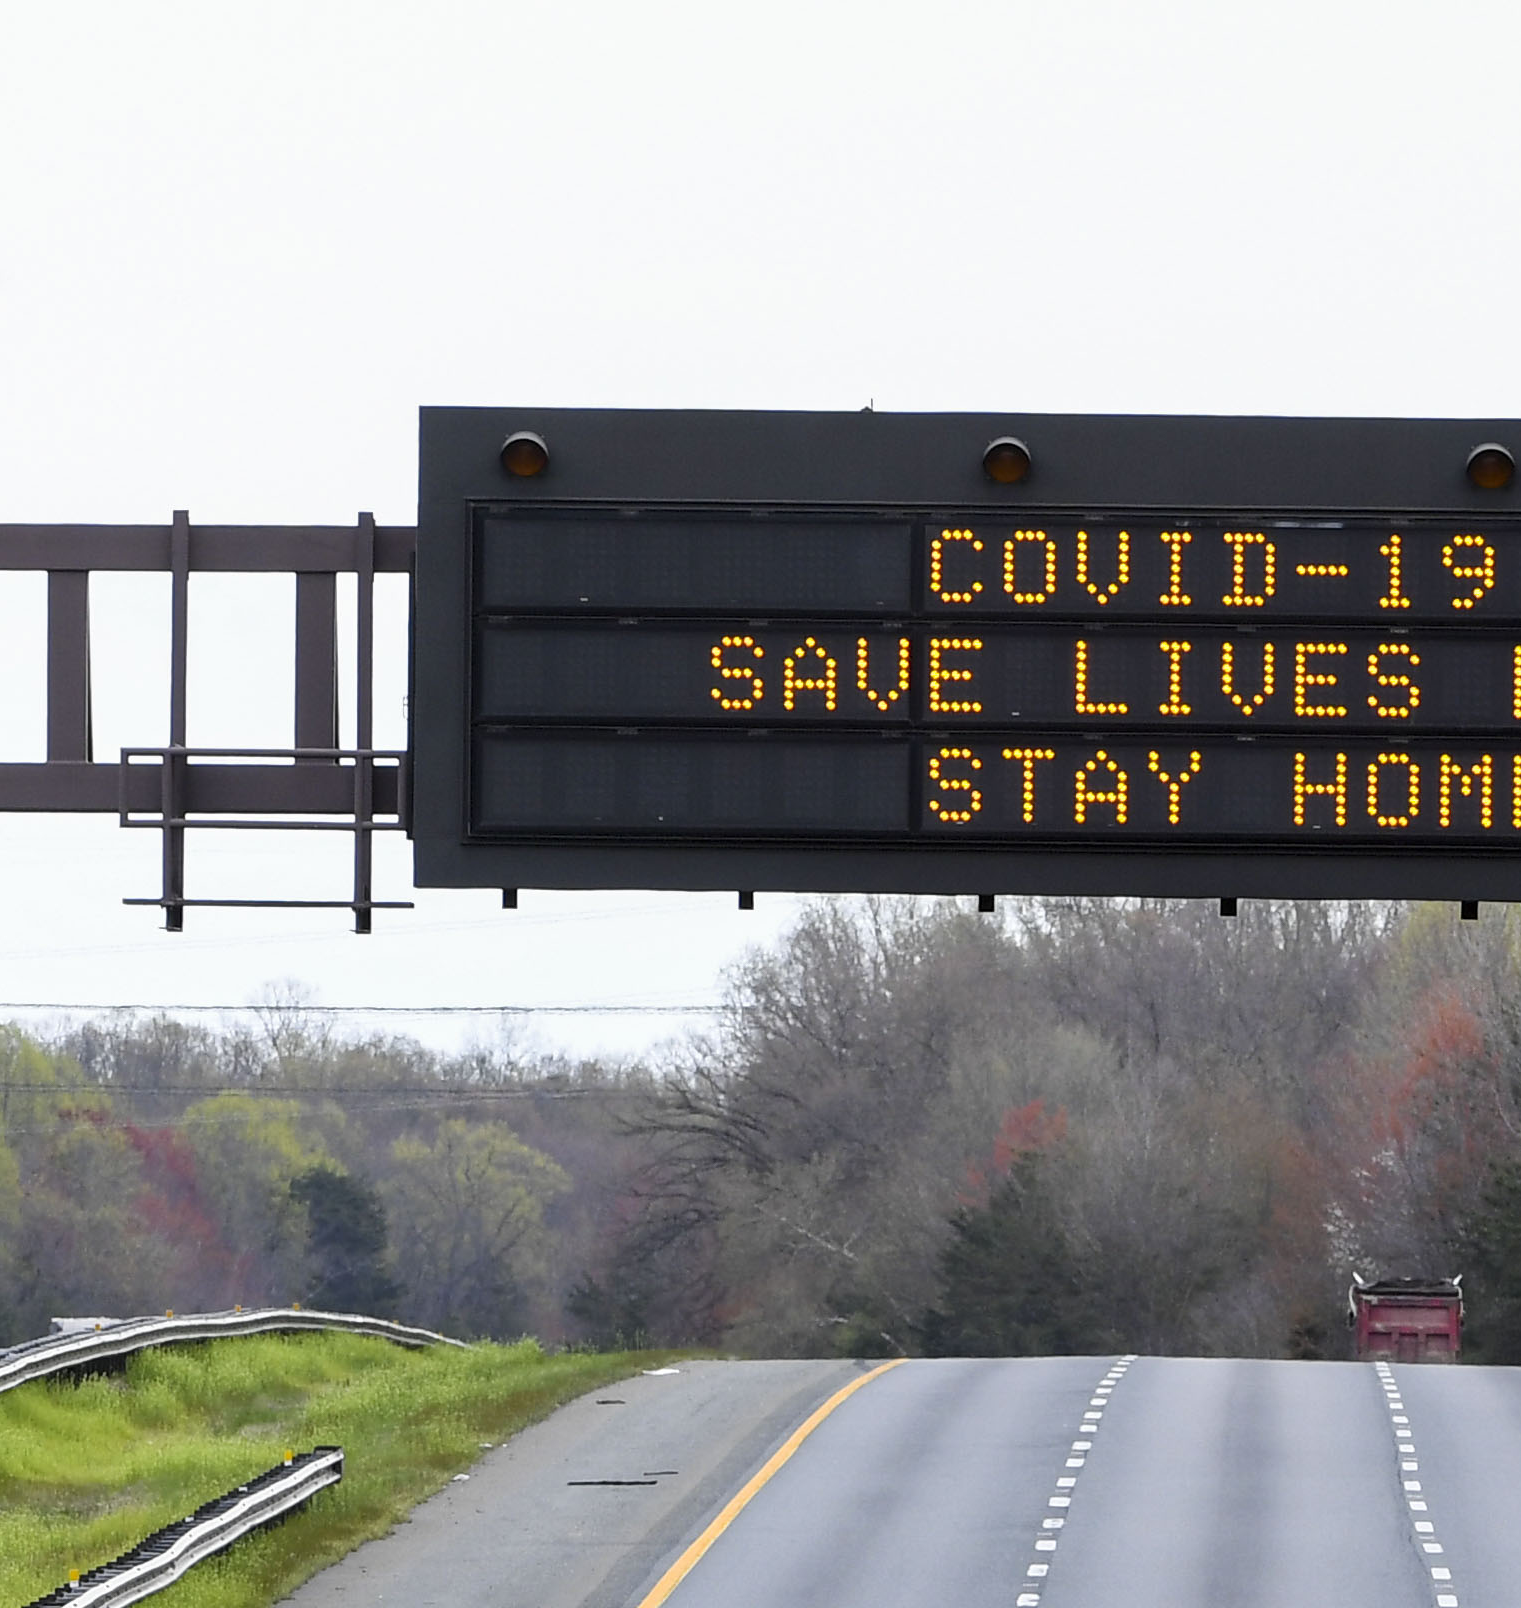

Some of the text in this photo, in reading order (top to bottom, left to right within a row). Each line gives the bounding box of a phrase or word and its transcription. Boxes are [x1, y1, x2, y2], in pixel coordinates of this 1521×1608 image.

[928, 528, 1496, 610] COVID-19
[708, 635, 984, 714] SAVE
[1073, 639, 1421, 719] LIVES
[927, 747, 1202, 826] STAY
